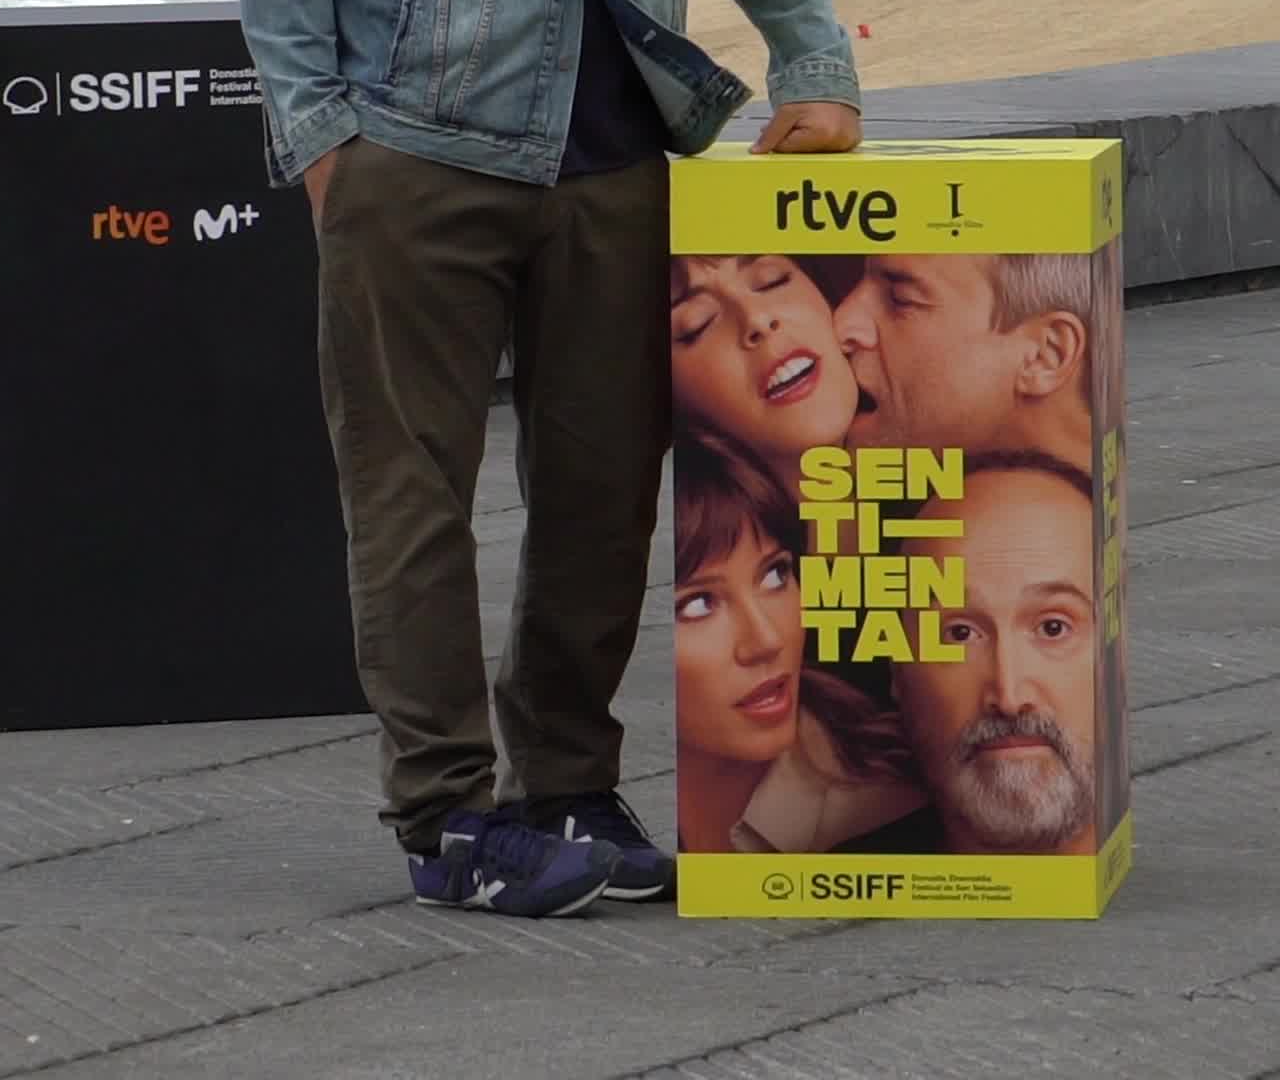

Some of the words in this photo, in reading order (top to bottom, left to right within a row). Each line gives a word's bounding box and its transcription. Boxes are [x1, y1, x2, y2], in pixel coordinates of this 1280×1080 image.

[70, 69, 200, 112] SSIFF
[92, 205, 170, 245] rtve
[777, 179, 897, 242] rtve
[799, 446, 964, 500] SEN
[800, 556, 965, 608] MEN
[800, 610, 965, 662] TAL
[811, 873, 905, 901] SSIFF
